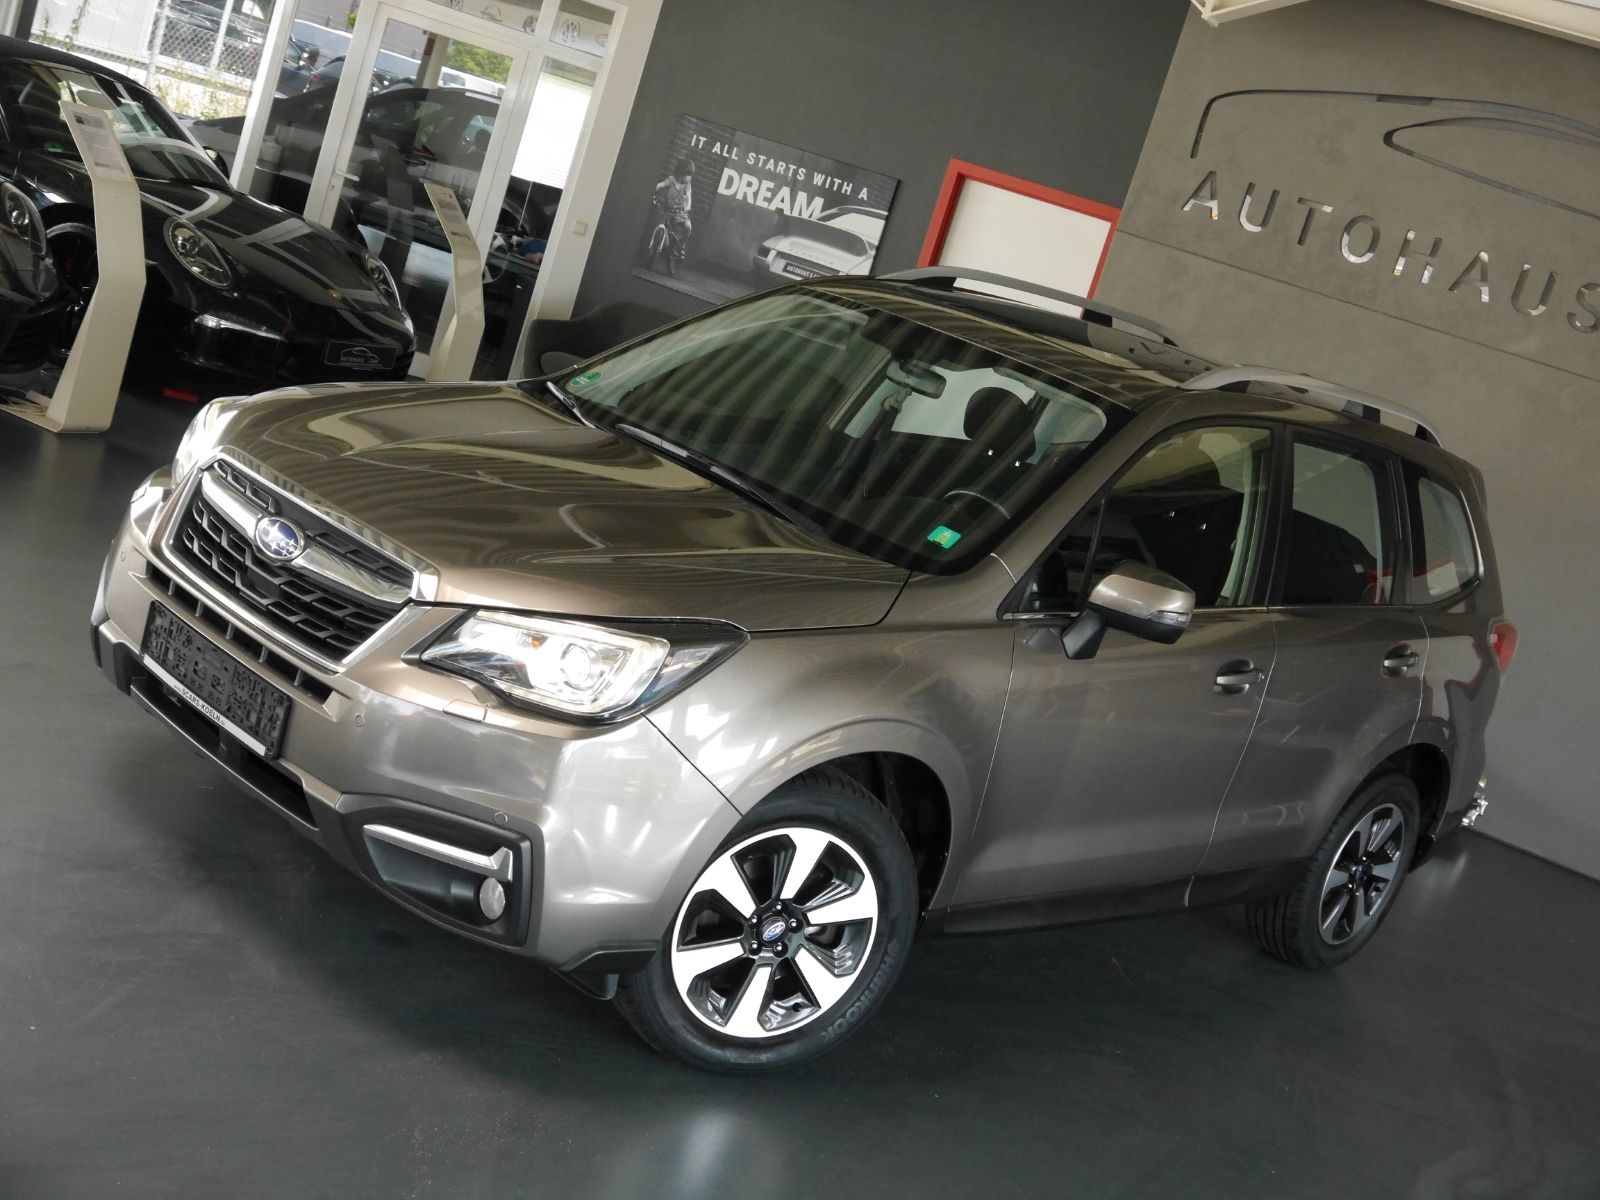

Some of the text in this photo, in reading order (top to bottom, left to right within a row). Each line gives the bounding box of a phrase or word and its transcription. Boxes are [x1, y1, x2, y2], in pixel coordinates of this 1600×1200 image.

[691, 134, 868, 201] IT ALL STARTS WITH A
[717, 167, 825, 220] DREAM
[1181, 170, 1600, 334] AUTOHAUS
